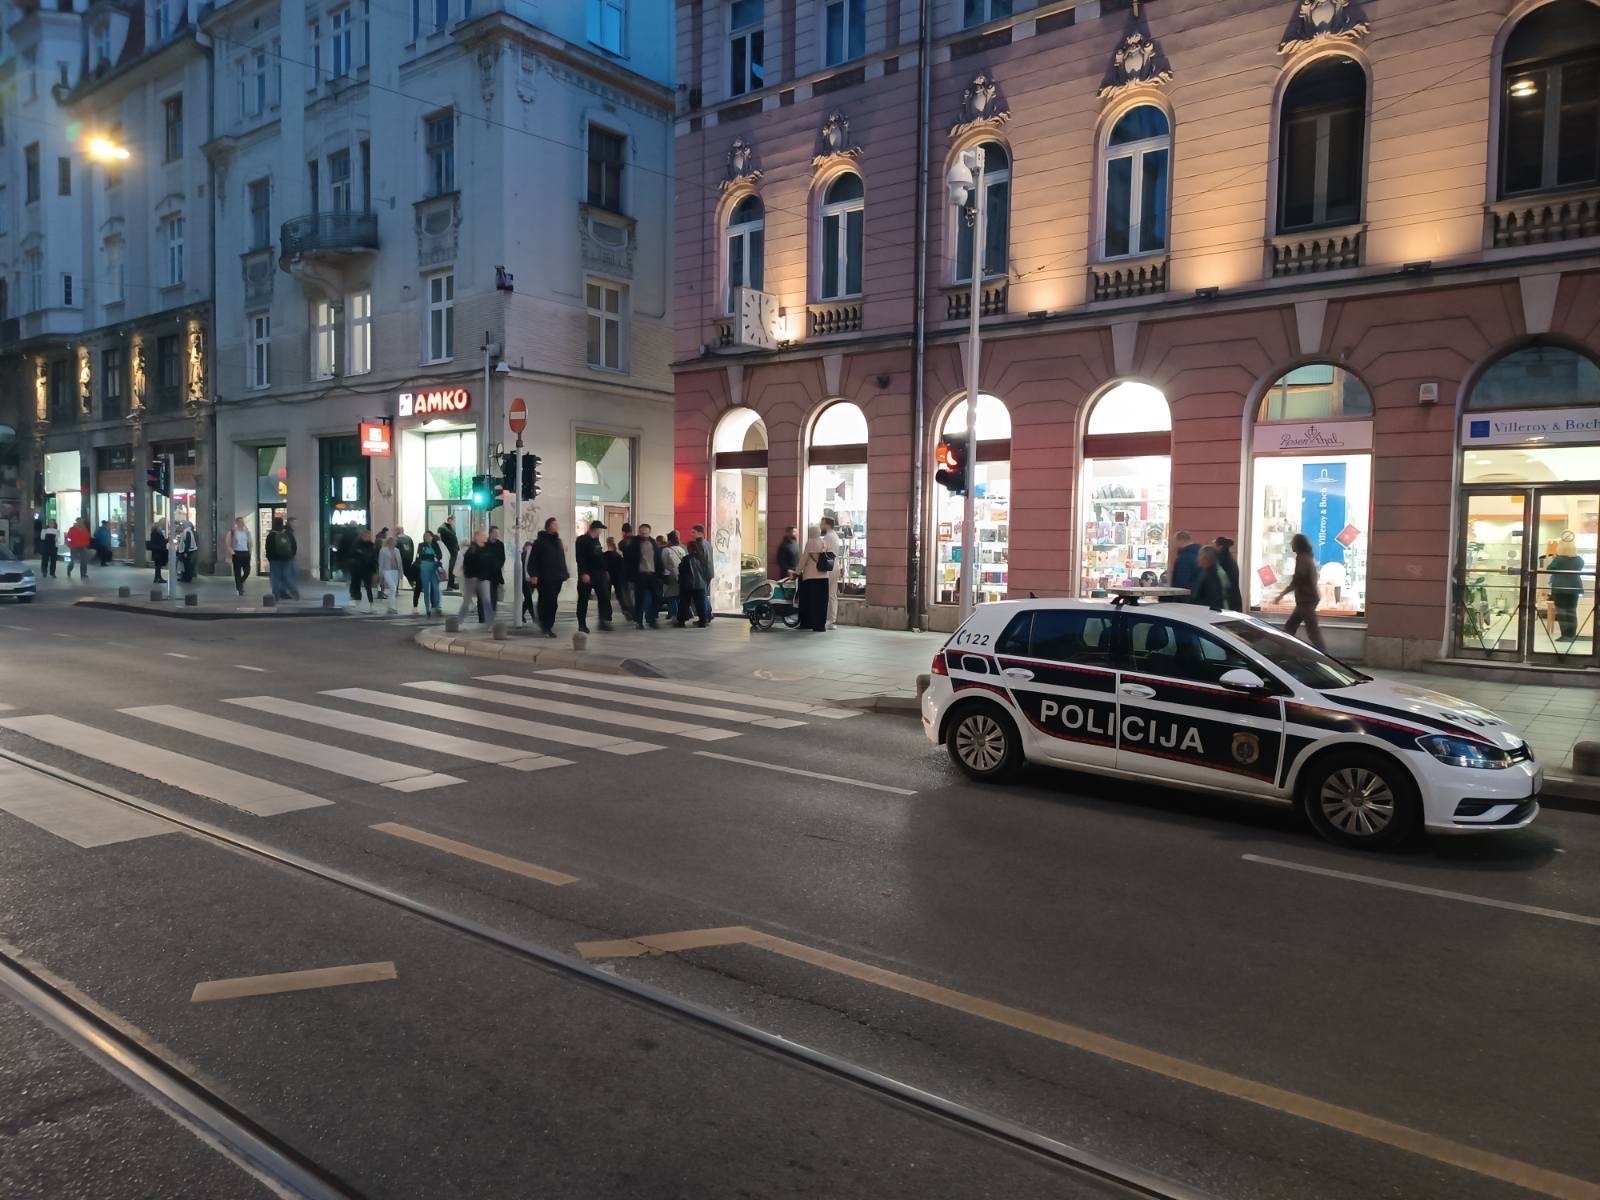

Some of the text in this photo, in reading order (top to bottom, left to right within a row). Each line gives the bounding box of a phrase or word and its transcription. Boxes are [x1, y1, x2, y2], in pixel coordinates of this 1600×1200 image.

[414, 388, 470, 414] AMKO
[1494, 421, 1548, 434] Villeroy
[1552, 422, 1561, 431] &
[1319, 487, 1328, 507] Boch
[966, 633, 990, 646] 122
[1040, 699, 1204, 754] POLICIJA
